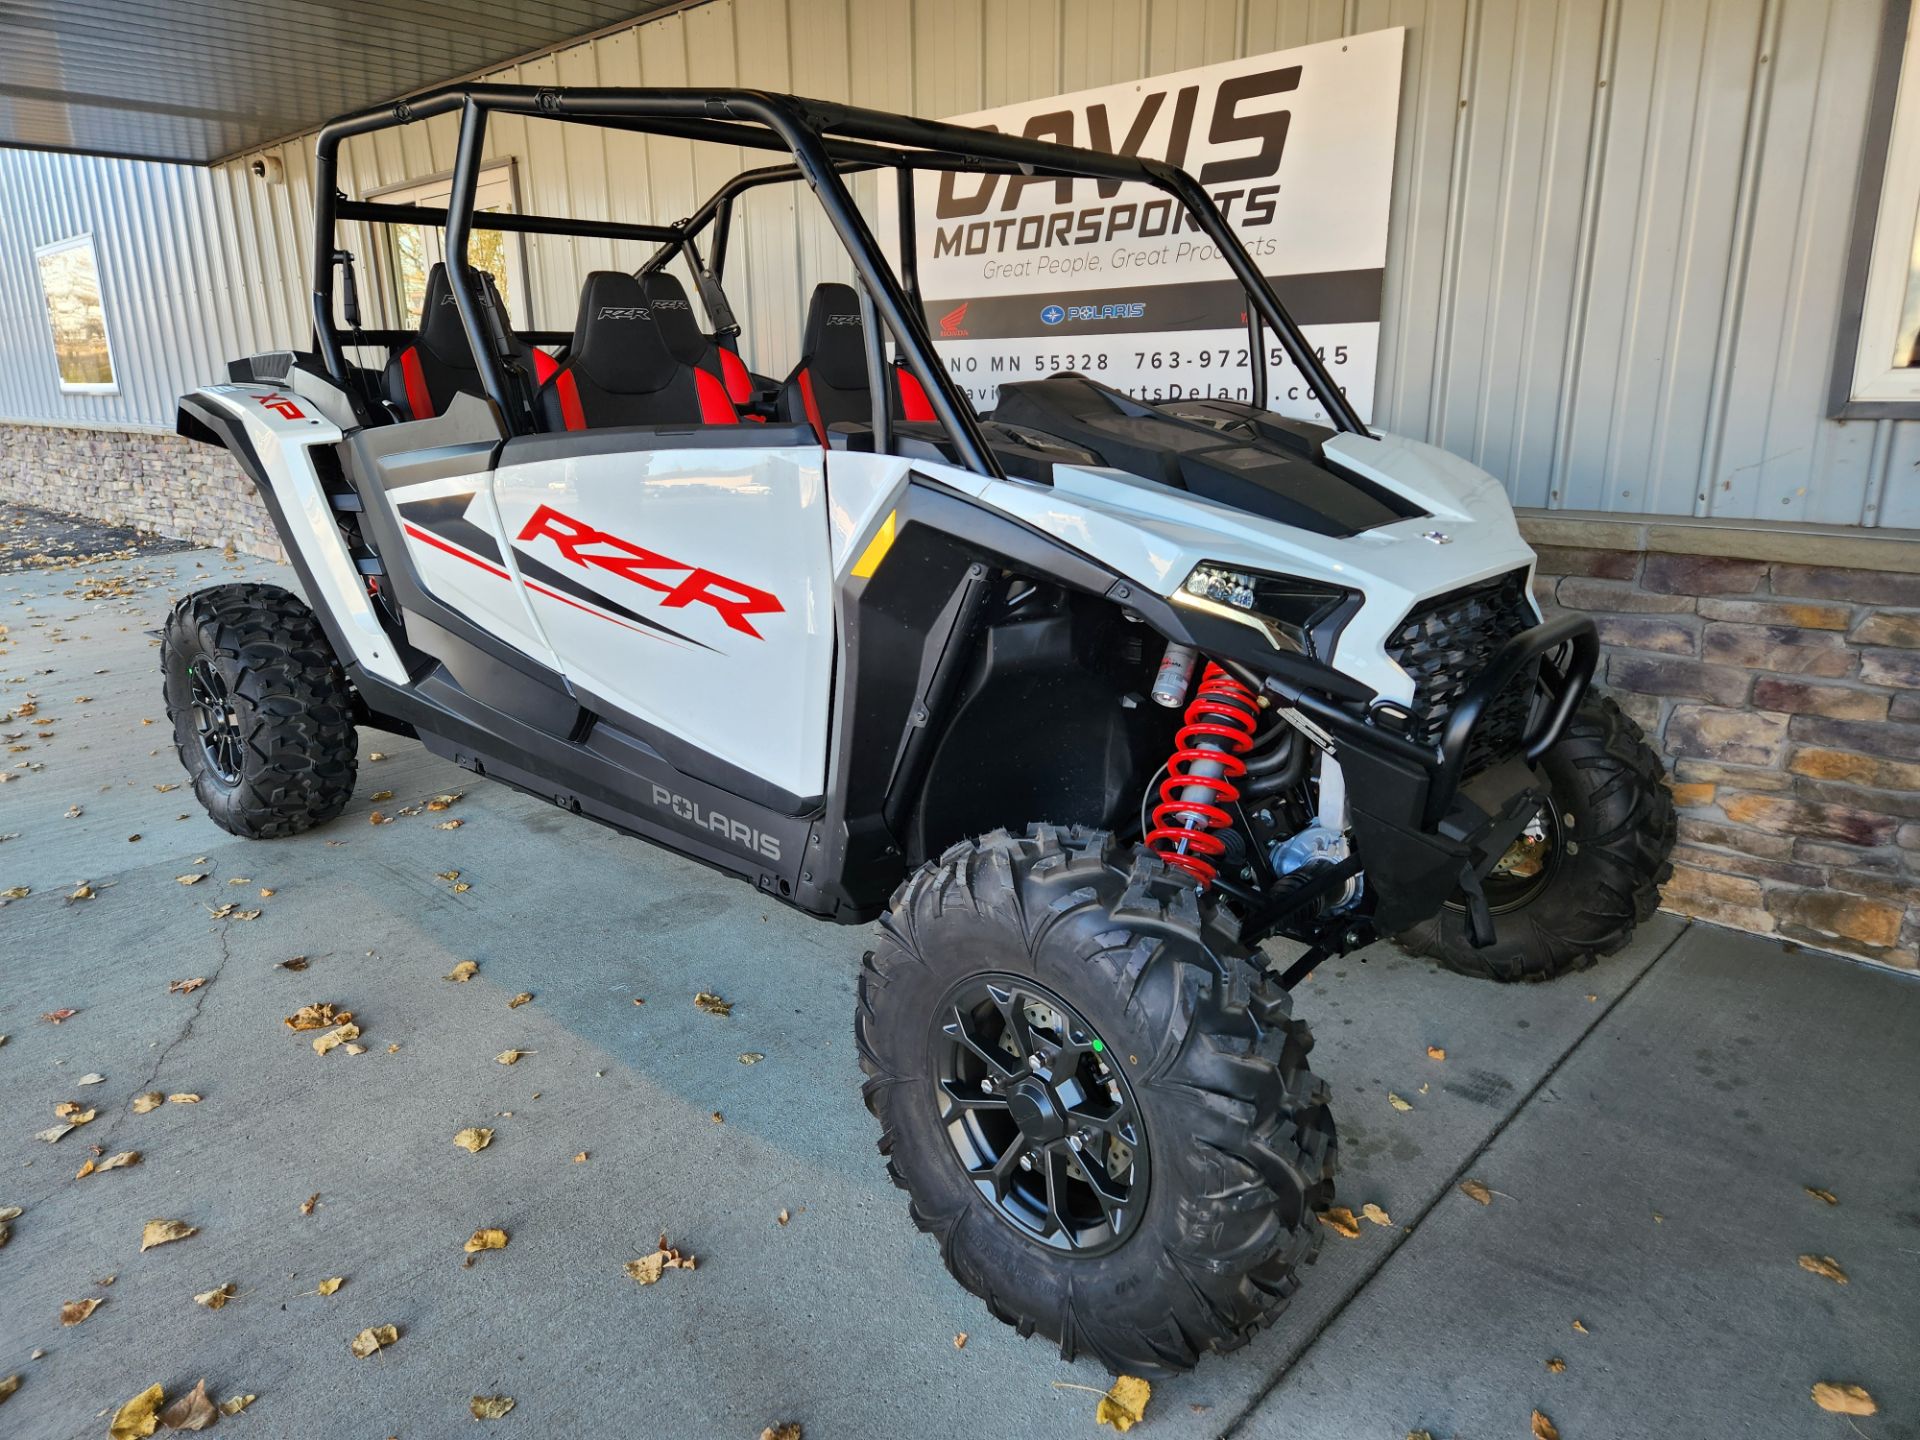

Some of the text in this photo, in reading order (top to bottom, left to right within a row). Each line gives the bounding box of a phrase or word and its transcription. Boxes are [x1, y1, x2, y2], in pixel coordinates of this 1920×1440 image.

[936, 65, 1303, 219] DAVIS
[934, 185, 1281, 259] MOTORSPORTS
[984, 259, 1031, 280] Great
[1037, 253, 1102, 278] People,
[1111, 244, 1169, 269] Great
[597, 306, 651, 320] RZR
[651, 299, 688, 310] RZR
[1068, 303, 1146, 320] POLARIS
[991, 355, 1021, 372] MN
[1035, 353, 1108, 371] 55328
[249, 393, 306, 420] XP
[516, 503, 786, 642] RZR
[652, 784, 781, 862] POLARIS
